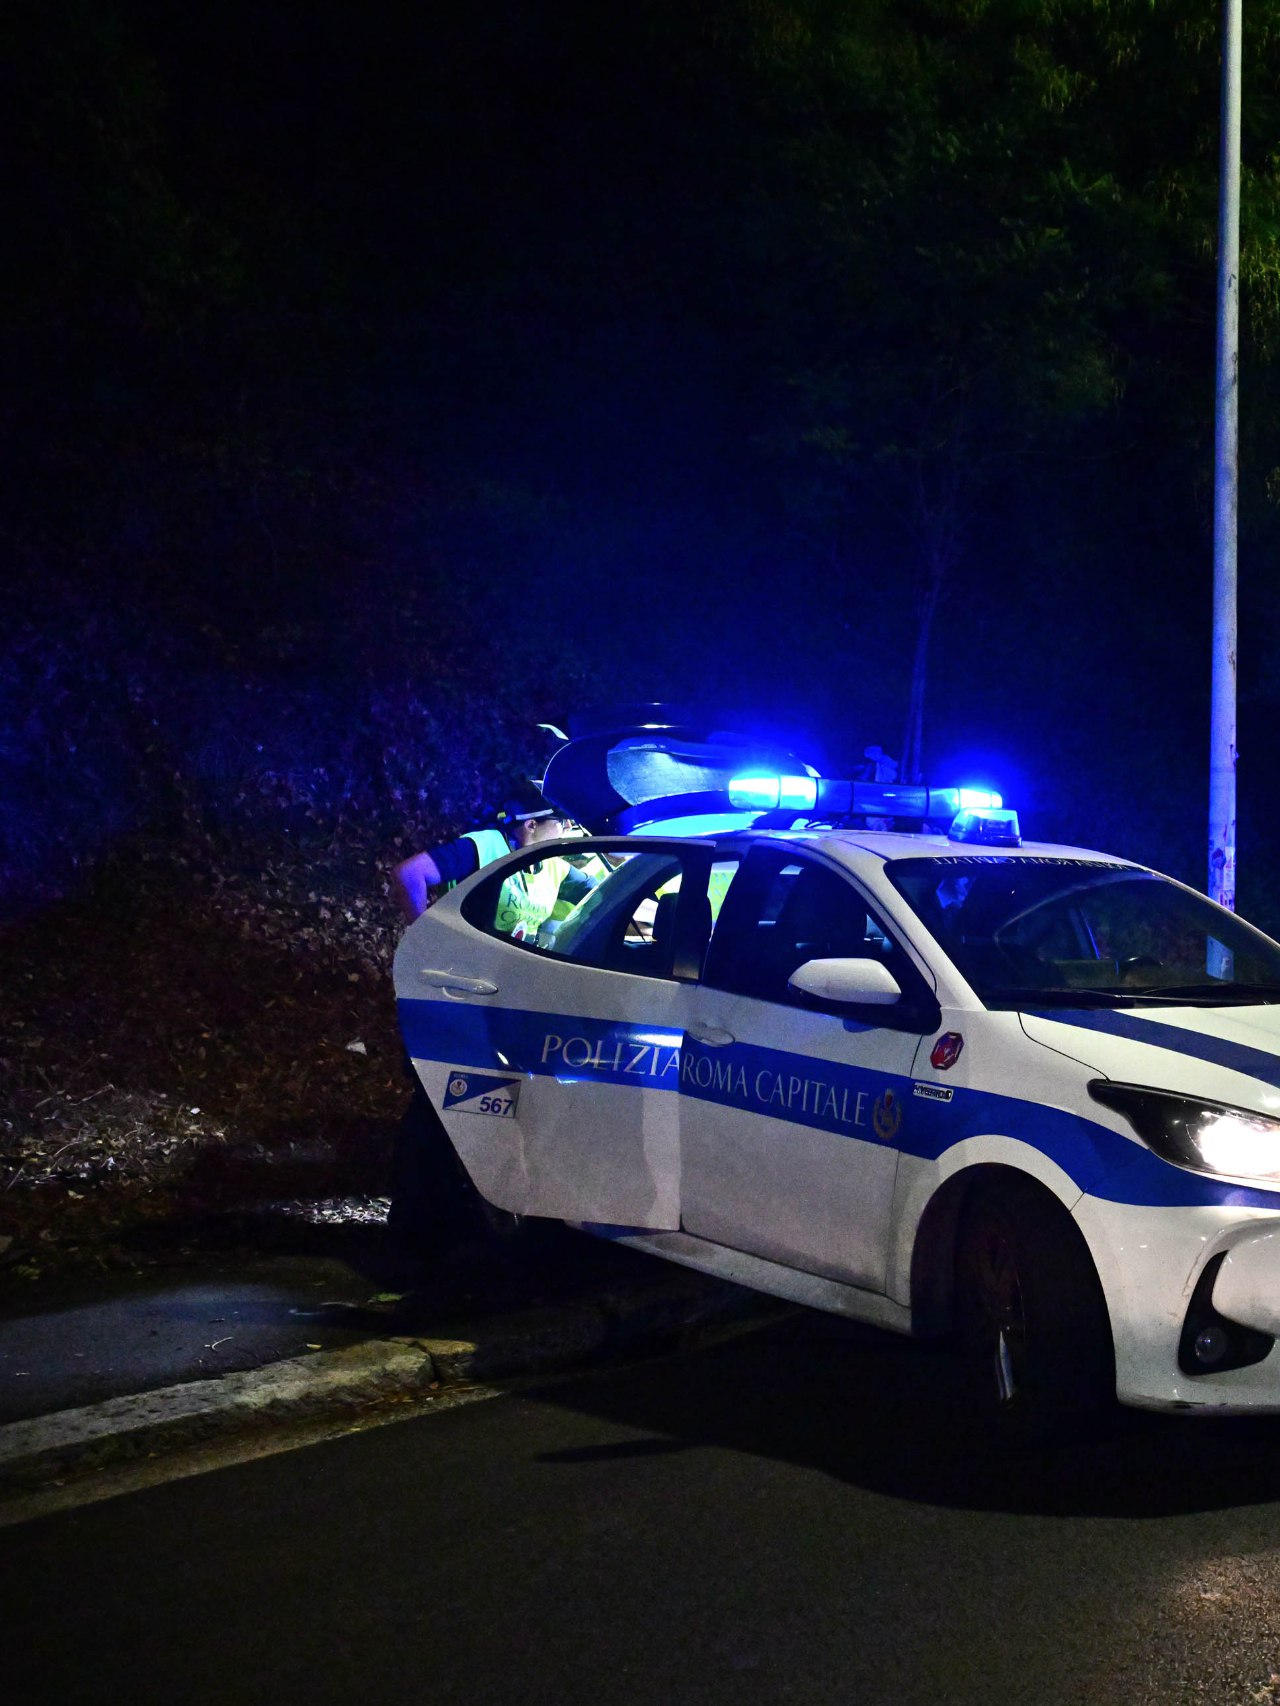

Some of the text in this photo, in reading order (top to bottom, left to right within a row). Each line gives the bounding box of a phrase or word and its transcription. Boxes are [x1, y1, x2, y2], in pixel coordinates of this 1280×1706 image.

[479, 1096, 513, 1115] 567
[540, 1034, 869, 1126] POLIZIA ROMA CAPITALE
